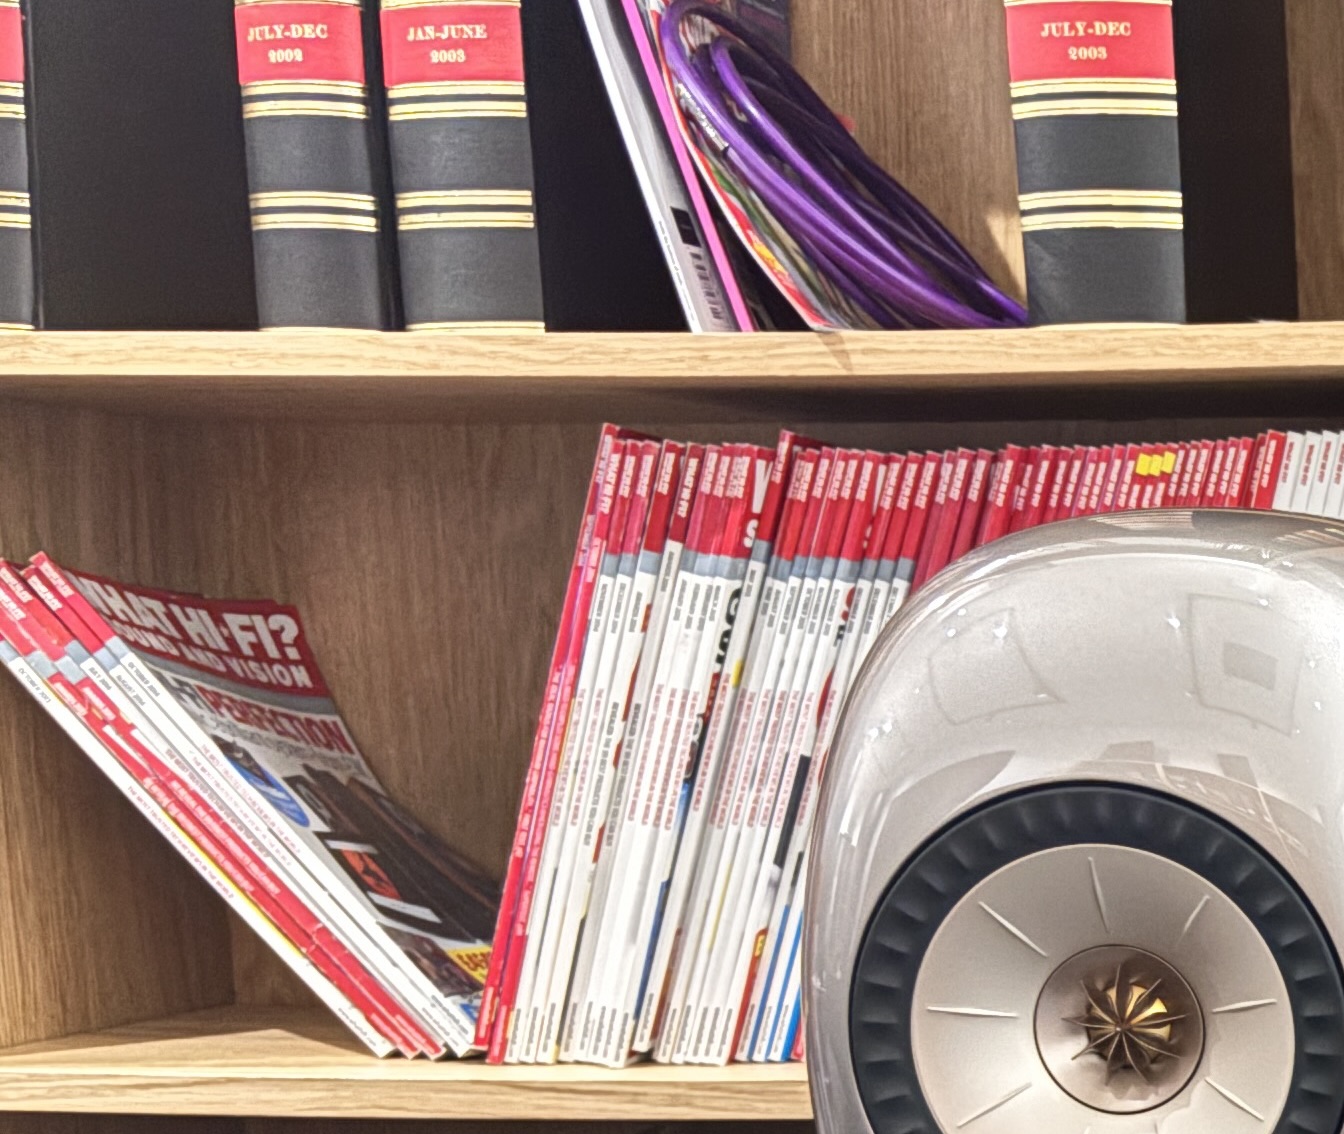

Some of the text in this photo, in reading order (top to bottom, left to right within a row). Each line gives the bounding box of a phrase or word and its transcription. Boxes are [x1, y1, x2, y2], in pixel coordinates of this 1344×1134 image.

[247, 24, 328, 42] JULY-DEC
[407, 24, 487, 42] JAN-JUNE
[1040, 21, 1131, 38] JULY-DEC
[268, 48, 303, 63] 2002
[1068, 46, 1107, 61] 2003
[224, 655, 314, 689] VISION
